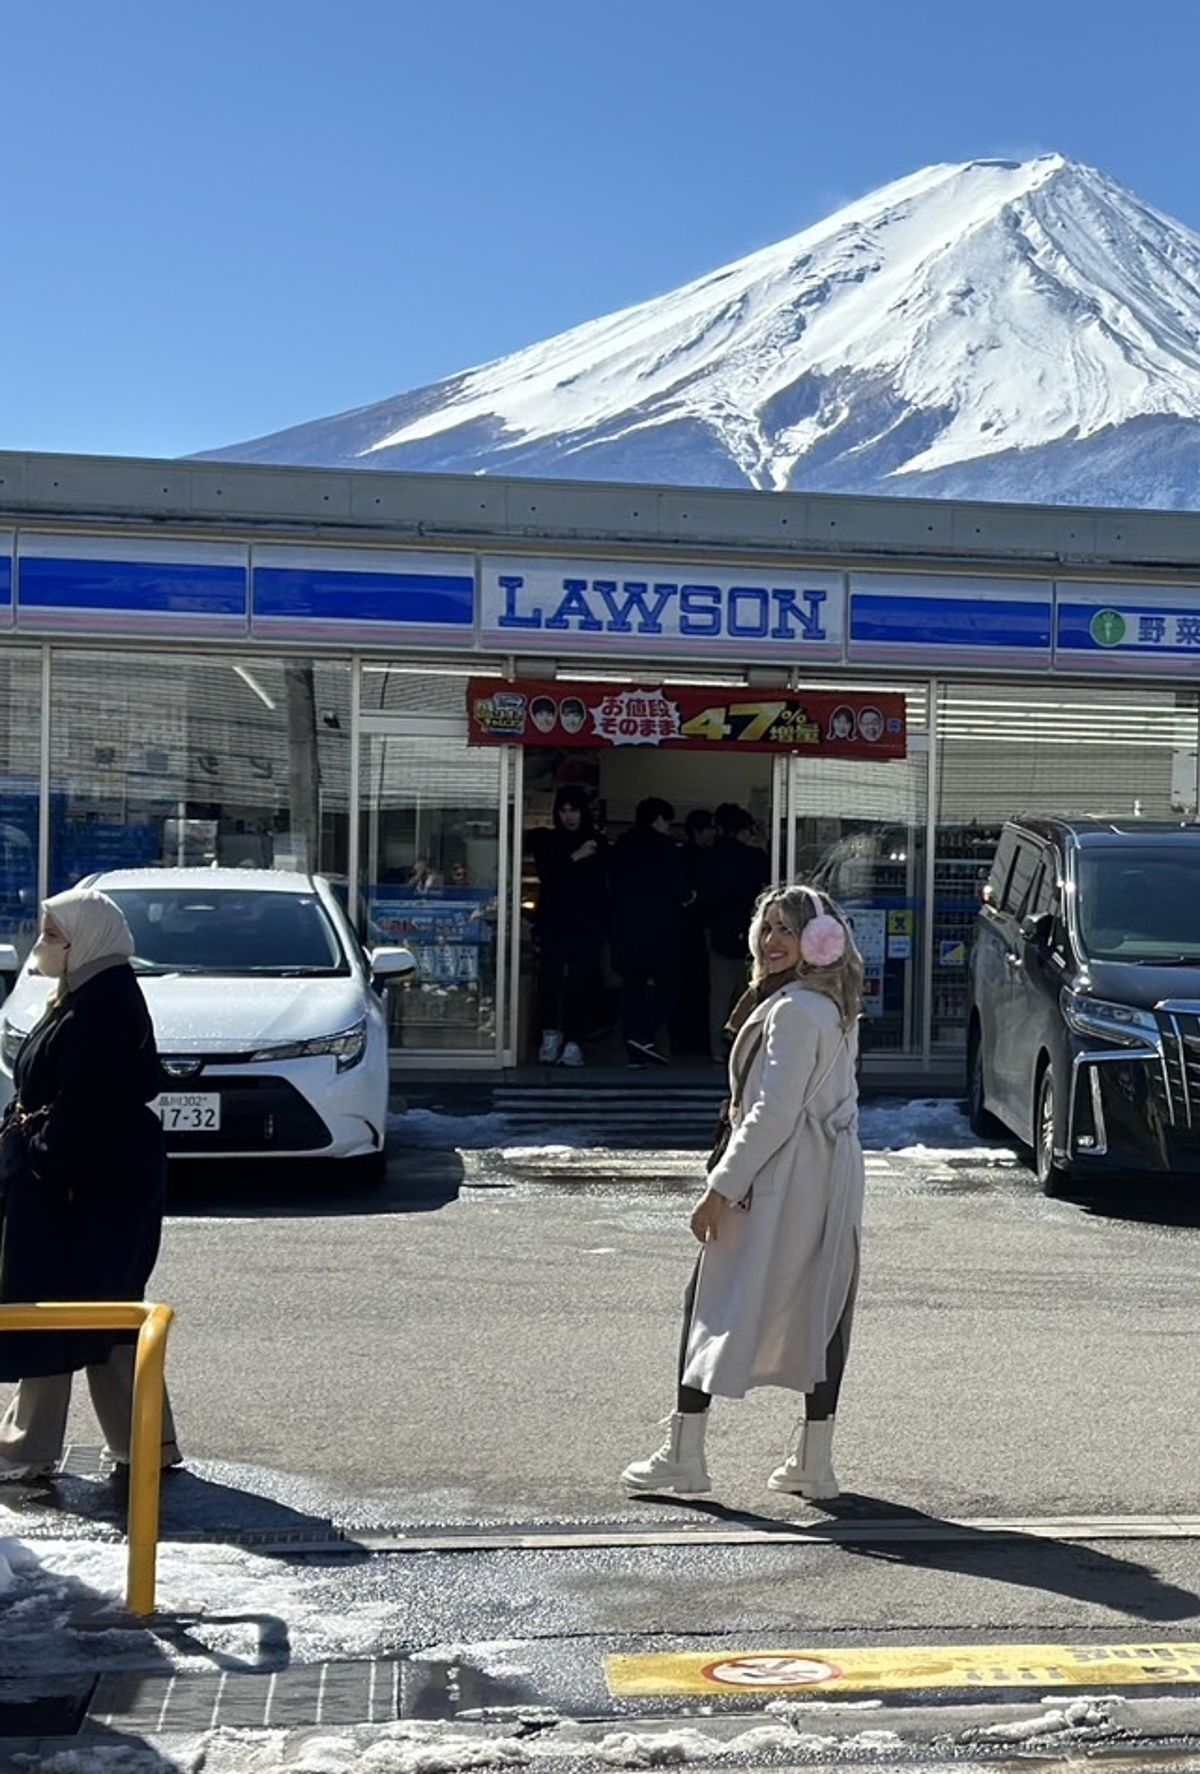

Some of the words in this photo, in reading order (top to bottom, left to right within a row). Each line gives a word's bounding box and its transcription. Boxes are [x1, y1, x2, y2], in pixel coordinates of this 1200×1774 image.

[498, 575, 827, 641] LAWSON
[602, 697, 673, 718] お値段
[601, 718, 676, 737] そのまま
[160, 1108, 216, 1128] 17-32
